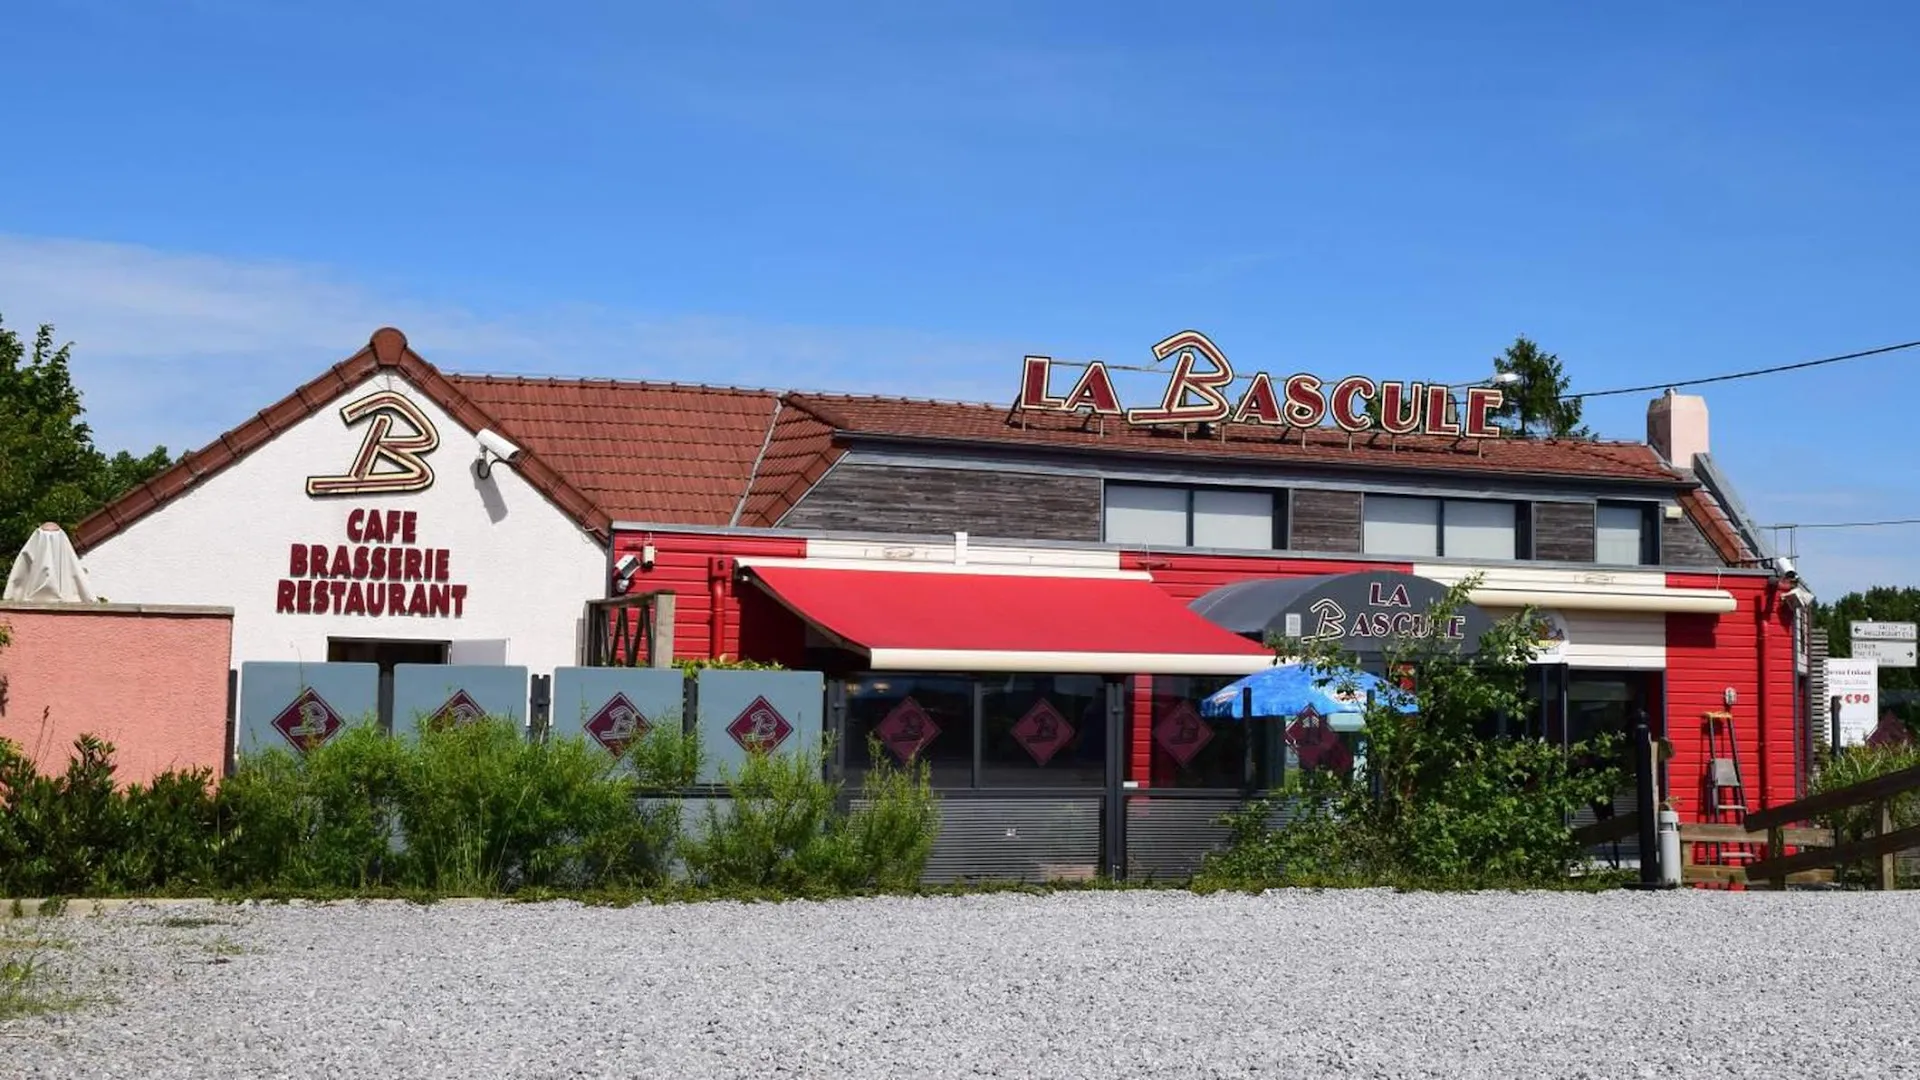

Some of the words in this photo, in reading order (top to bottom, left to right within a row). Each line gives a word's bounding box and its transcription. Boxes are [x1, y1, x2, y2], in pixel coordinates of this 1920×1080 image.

[1020, 355, 1121, 415] LA
[1127, 329, 1503, 439] BASCULE
[306, 390, 439, 497] B
[347, 508, 417, 544] CAFE
[289, 543, 450, 582] BRASSERIE
[276, 579, 467, 618] RESTAURANT
[1369, 582, 1411, 608] LA
